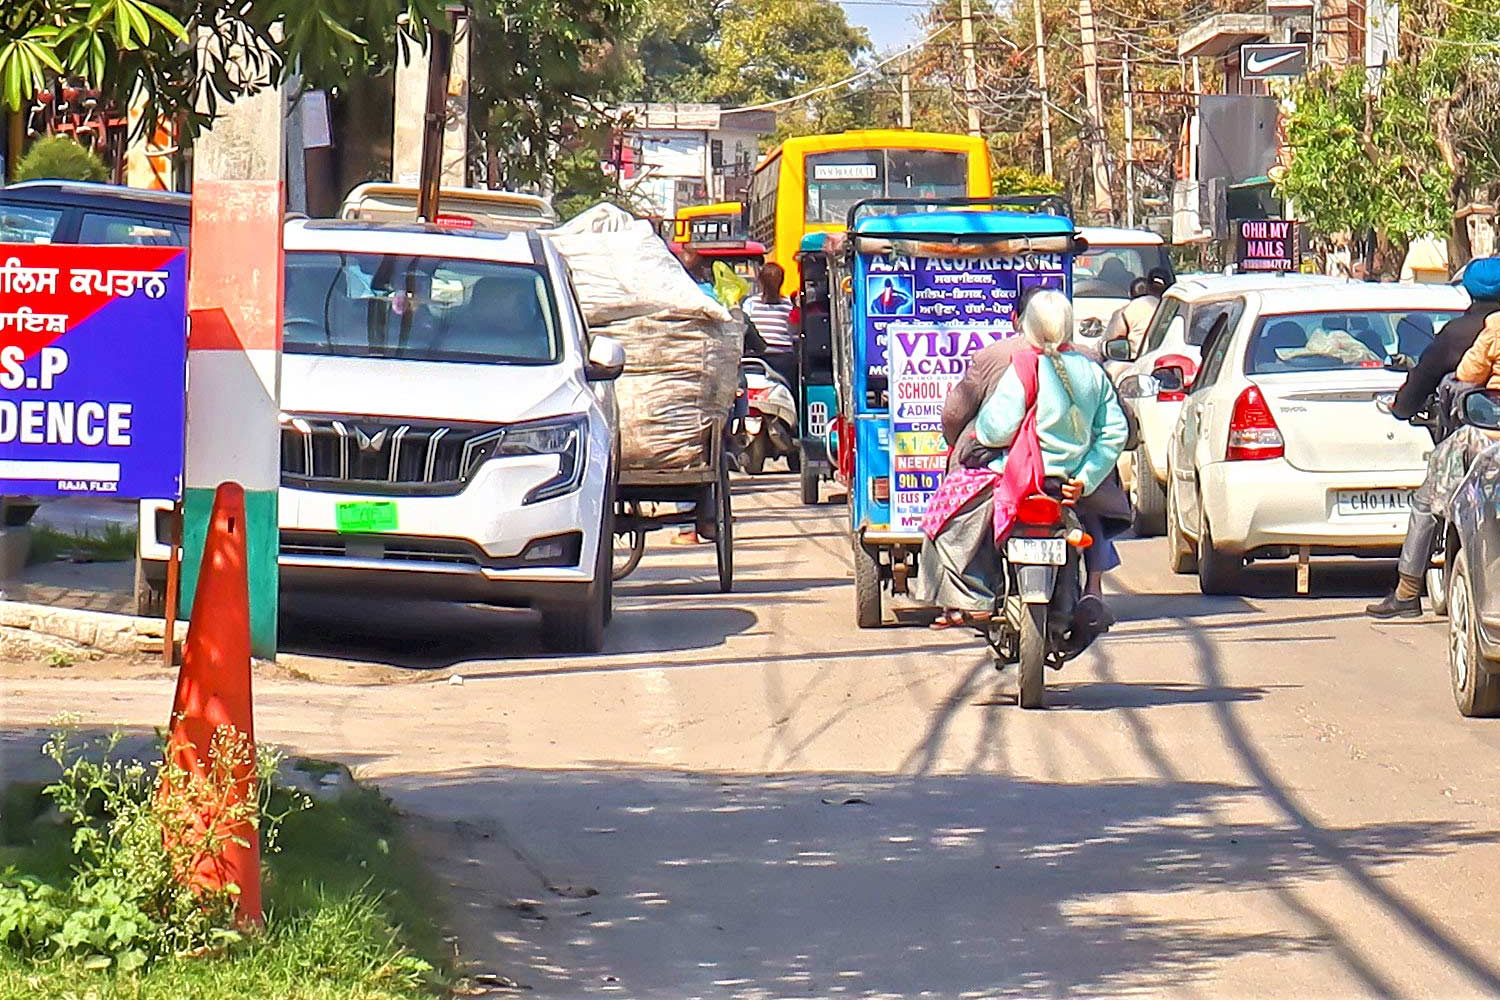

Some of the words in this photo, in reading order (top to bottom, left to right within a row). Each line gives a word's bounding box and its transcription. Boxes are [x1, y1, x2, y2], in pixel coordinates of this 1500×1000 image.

[1242, 222, 1267, 239] OHH
[1247, 240, 1285, 257] NAILS
[70, 268, 169, 299] ਕਪਤਾਨ
[898, 382, 942, 399] SCHOOL
[58, 481, 88, 491] RAJA
[90, 482, 117, 491] FLEX
[899, 473, 918, 489] 9th
[921, 473, 933, 489] to
